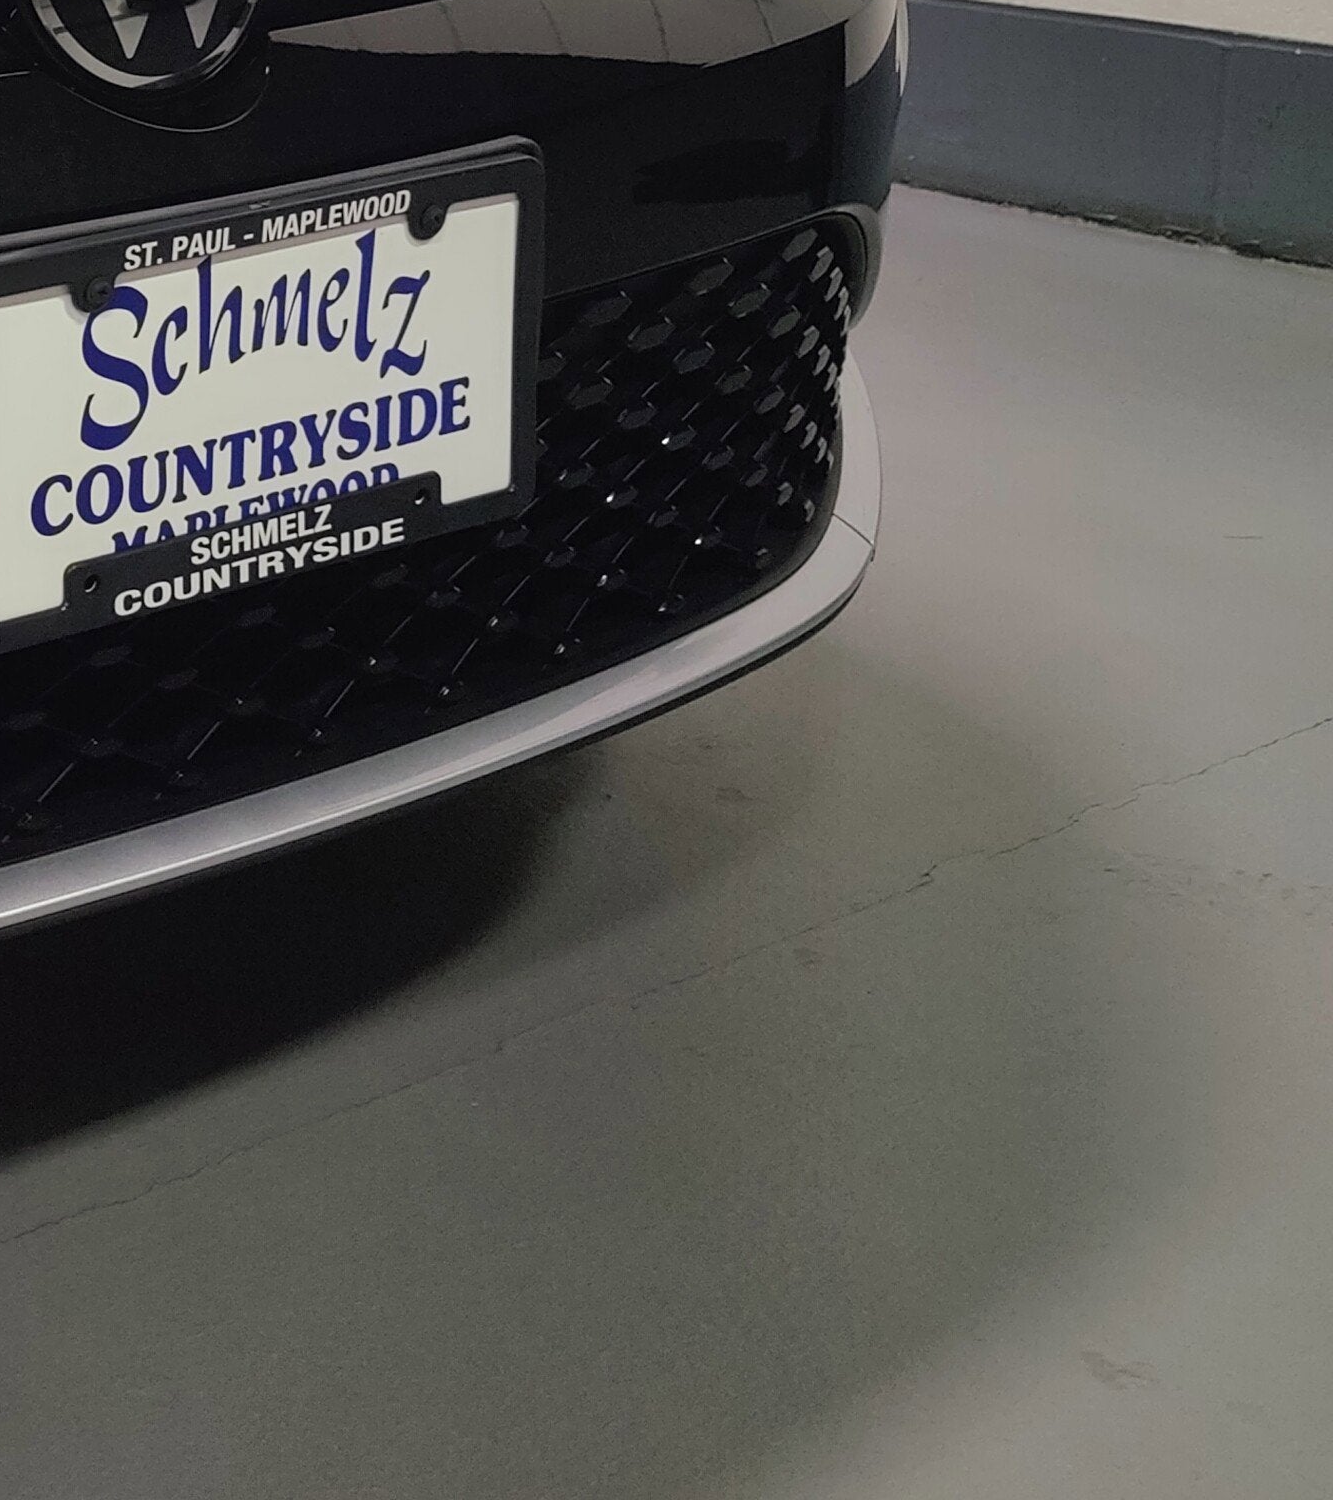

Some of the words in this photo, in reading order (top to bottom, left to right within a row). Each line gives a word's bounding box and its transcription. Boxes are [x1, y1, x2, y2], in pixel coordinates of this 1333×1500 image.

[123, 241, 163, 271] ST.
[171, 226, 236, 262] PAUL
[261, 189, 411, 243] MAPLEWOOD
[80, 229, 431, 451] Schmelz
[30, 376, 471, 537] COUNTRYSIDE
[114, 517, 406, 617] COUNTRYSIDE
[190, 503, 333, 565] SCHMELZ
